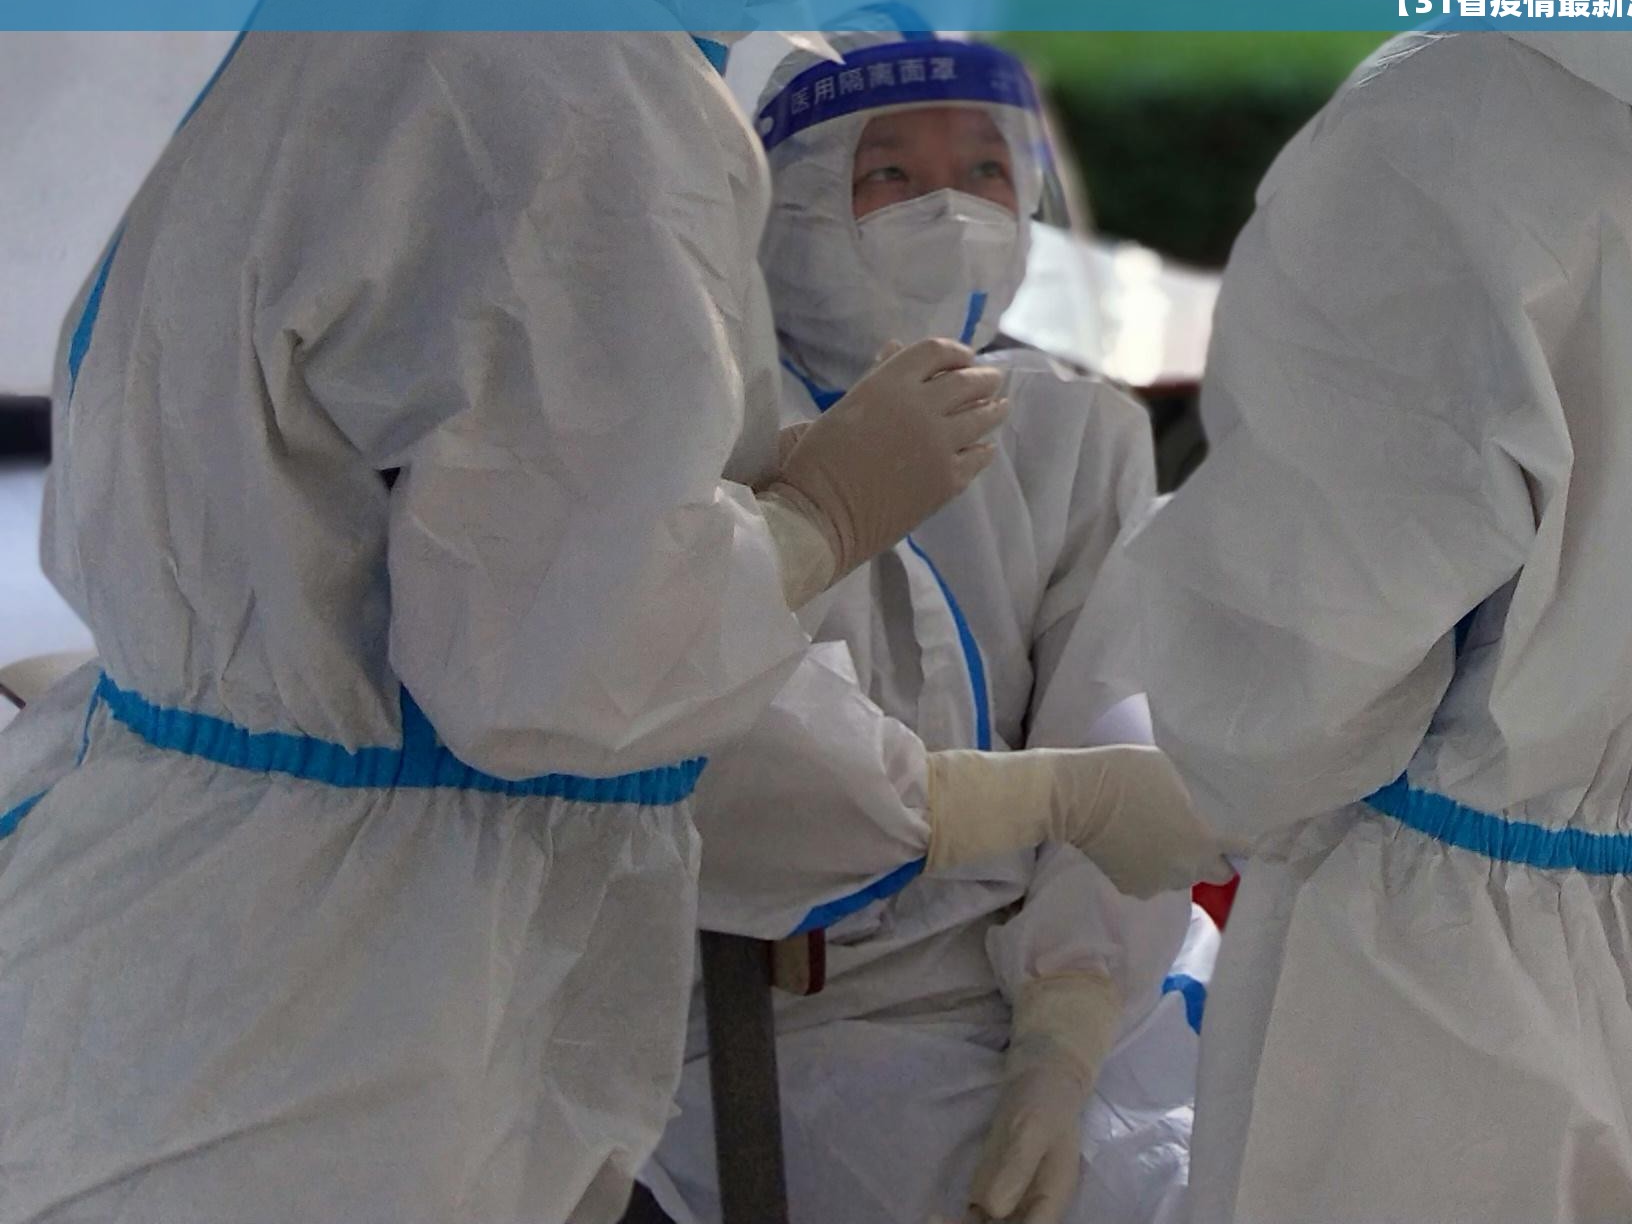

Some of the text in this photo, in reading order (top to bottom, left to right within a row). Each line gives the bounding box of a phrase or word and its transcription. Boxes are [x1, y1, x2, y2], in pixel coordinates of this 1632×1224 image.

[790, 57, 957, 115] 医用隔离面罩
